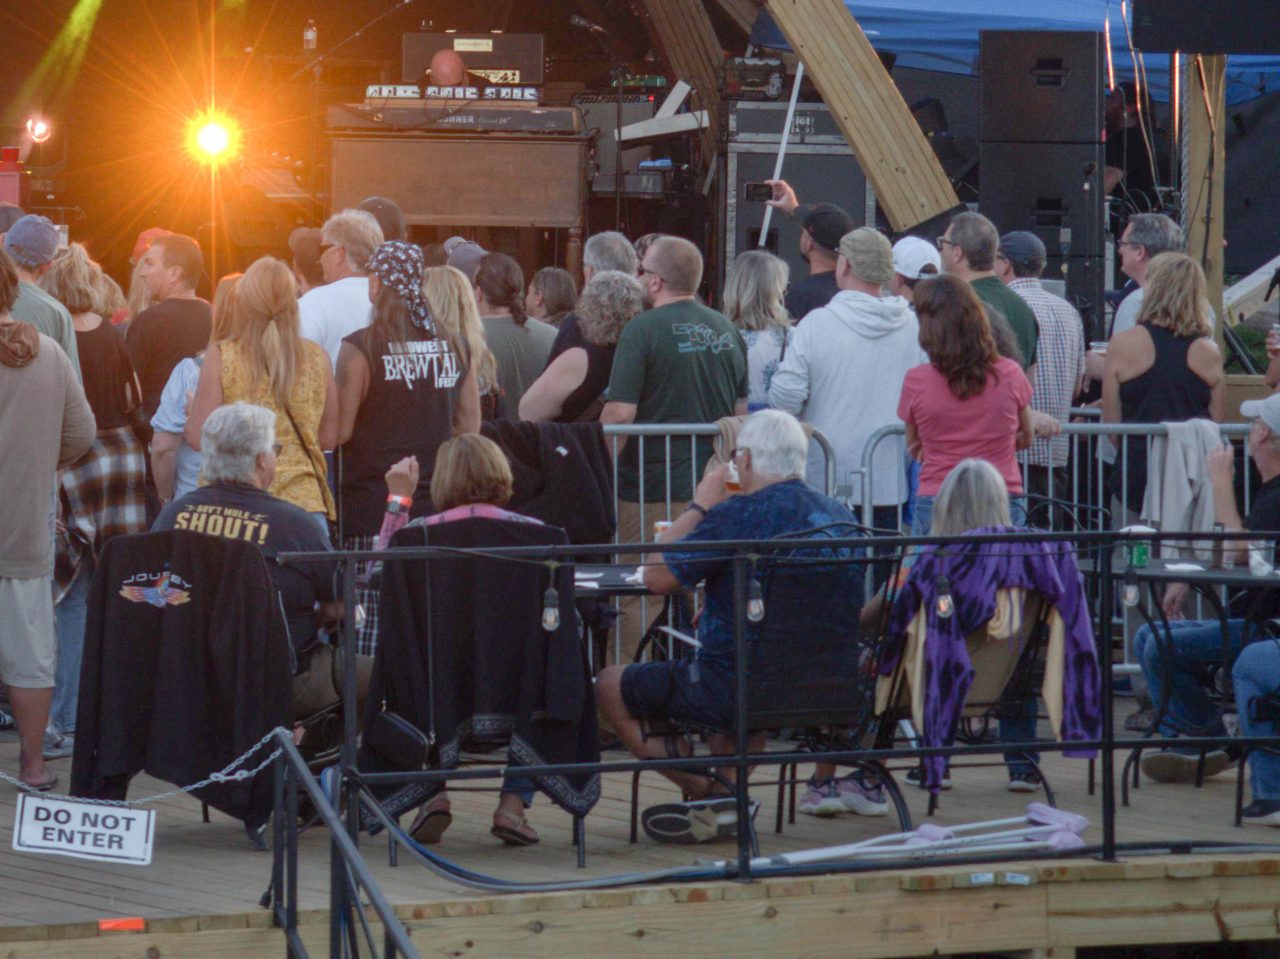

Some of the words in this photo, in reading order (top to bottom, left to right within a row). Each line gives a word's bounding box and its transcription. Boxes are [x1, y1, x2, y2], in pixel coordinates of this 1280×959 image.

[382, 352, 460, 390] BREWTAL
[174, 511, 269, 545] SHOUT!
[33, 806, 72, 825] DO
[81, 811, 136, 832] NOT
[42, 826, 124, 850] ENTER
